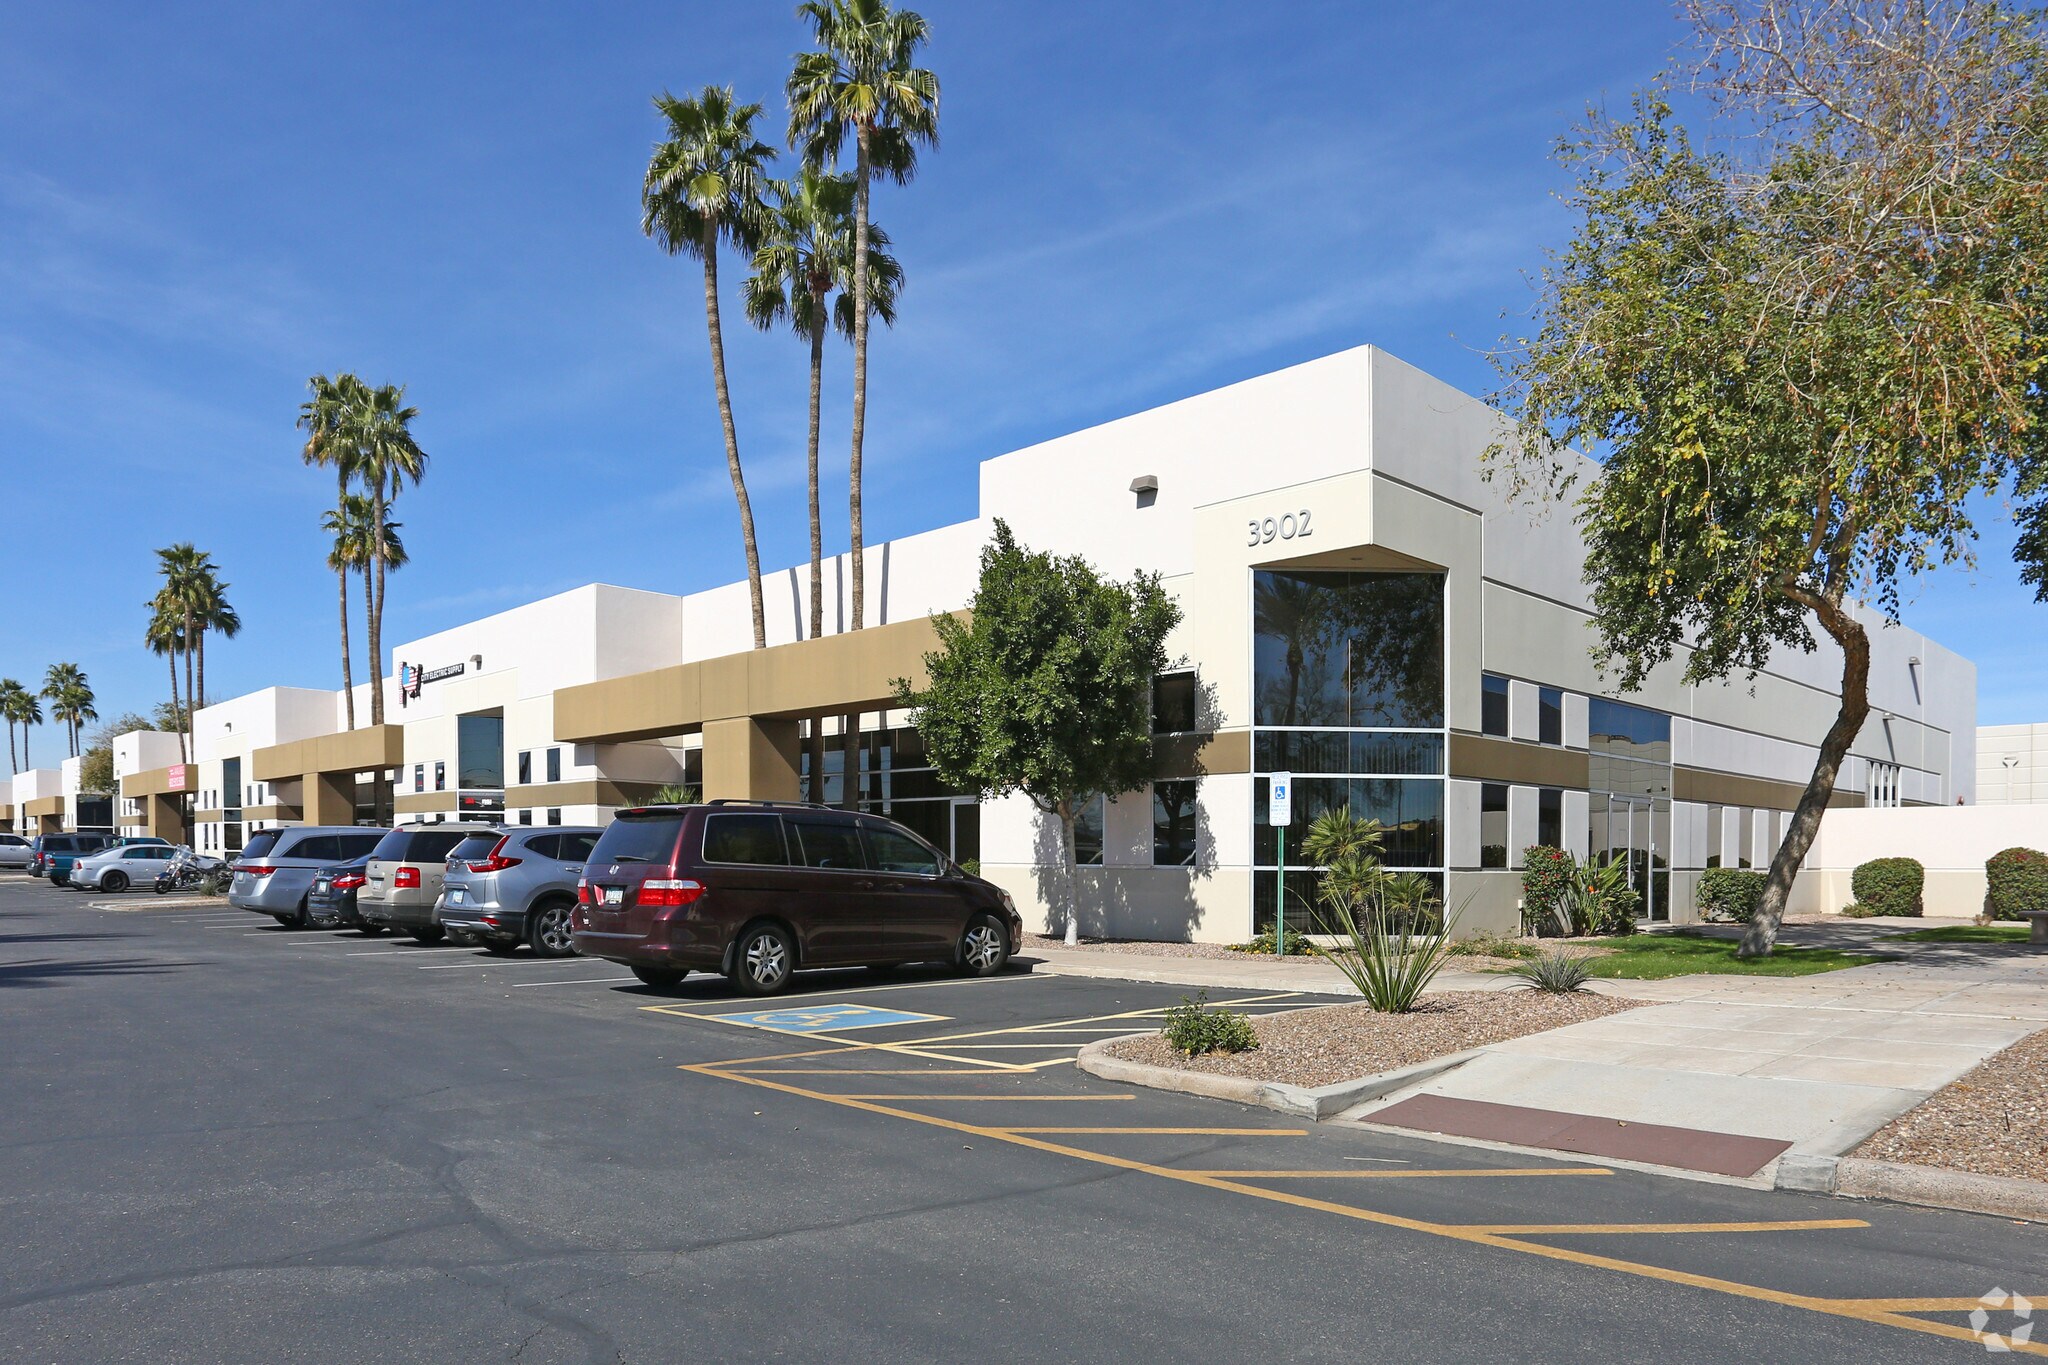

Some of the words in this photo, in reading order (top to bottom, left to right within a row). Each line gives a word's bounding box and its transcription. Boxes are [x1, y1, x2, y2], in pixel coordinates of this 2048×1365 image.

[1248, 509, 1313, 547] 3902
[430, 667, 447, 680] ELECTRIC
[448, 664, 463, 675] SUPPLY
